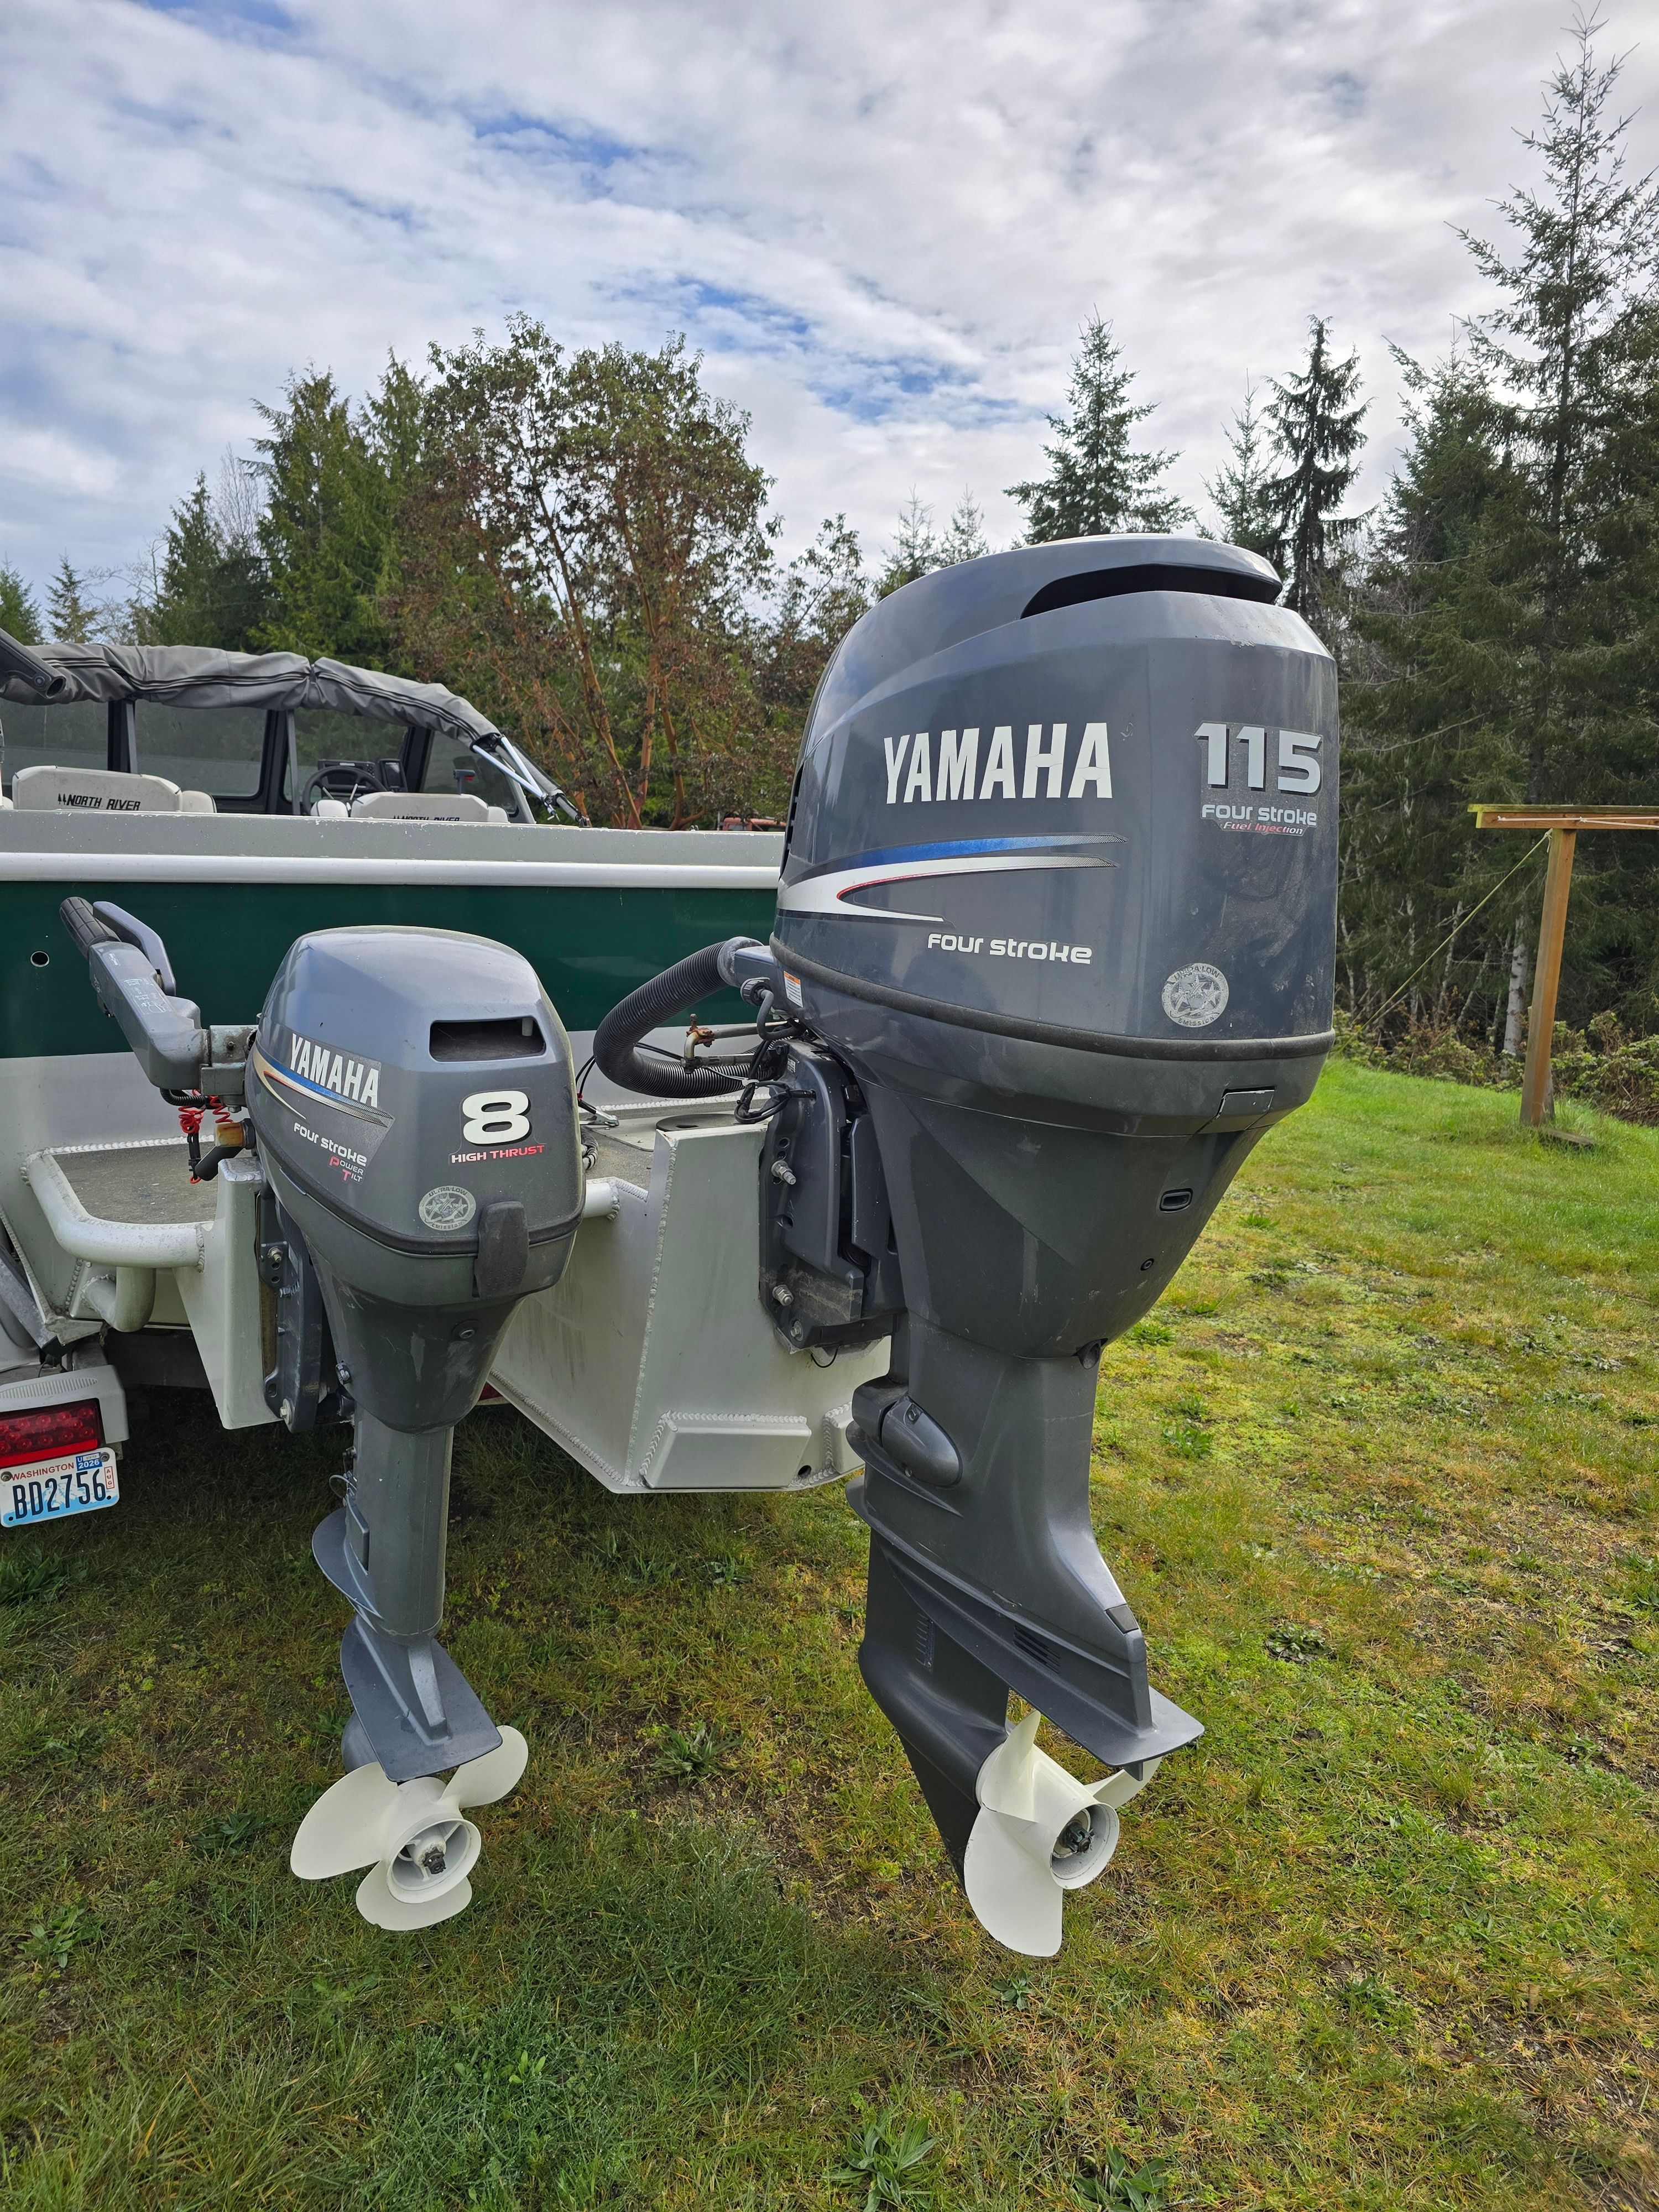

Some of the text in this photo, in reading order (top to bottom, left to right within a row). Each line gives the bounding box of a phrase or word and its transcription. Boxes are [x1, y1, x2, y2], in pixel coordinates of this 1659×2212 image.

[884, 723, 1113, 804] YAMAHA
[1194, 723, 1322, 795] 115
[66, 794, 140, 811] NORTH RIVER
[1223, 821, 1303, 834] Fuel Injection
[290, 1033, 379, 1108] YAMAHA
[462, 1091, 532, 1145] 8
[451, 1145, 545, 1164] HIGH THRUST
[329, 1156, 364, 1176] POWER
[11, 1462, 74, 1481] WASHINGTON
[78, 1459, 100, 1469] 2026
[12, 1468, 106, 1519] BD2756
